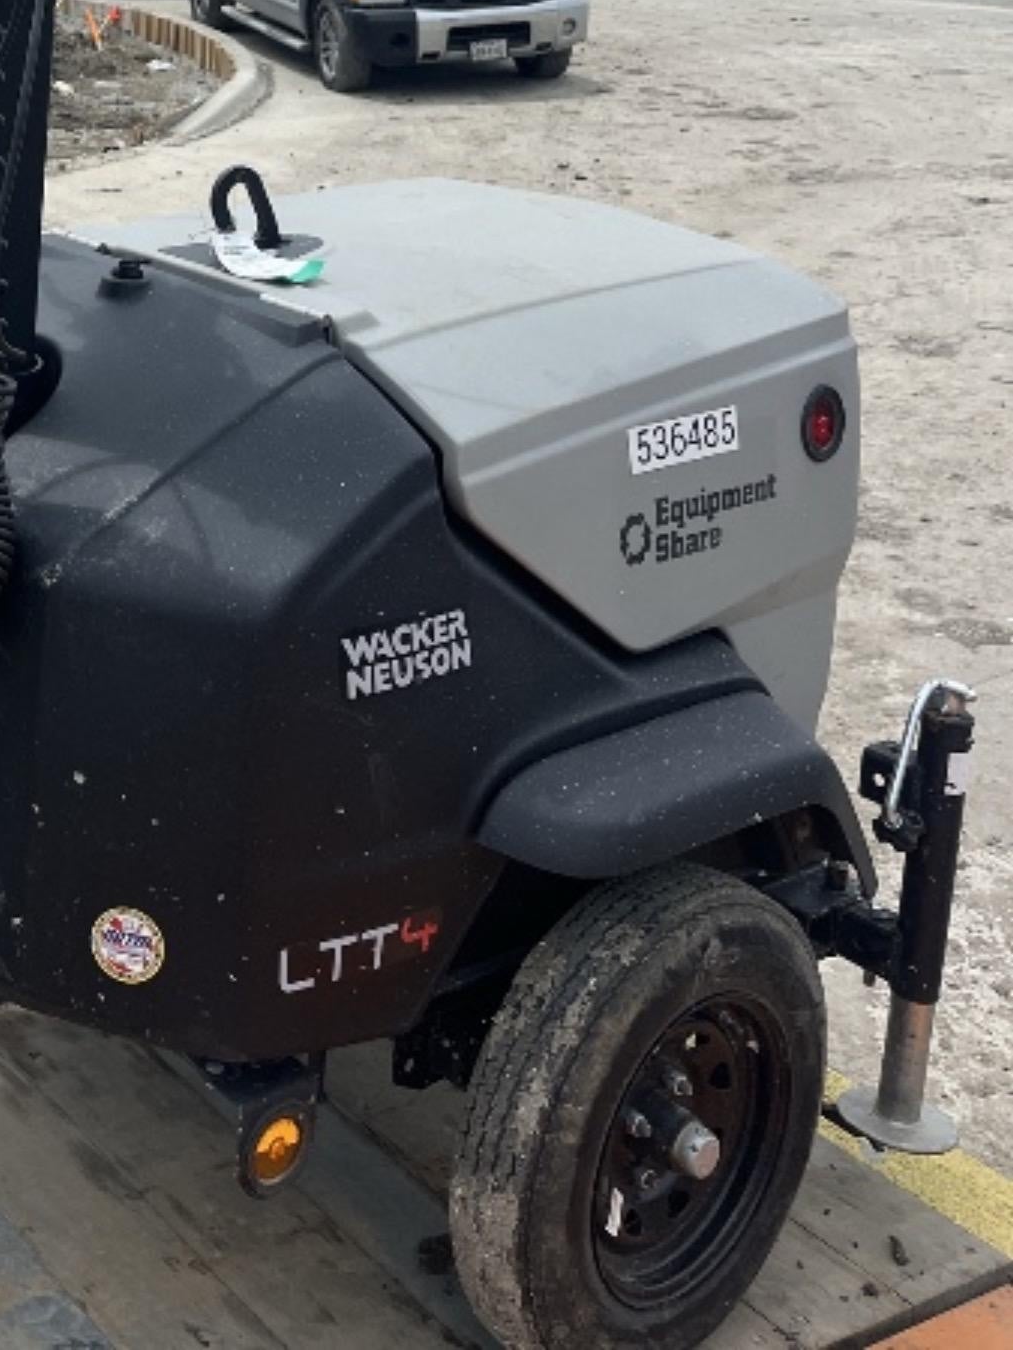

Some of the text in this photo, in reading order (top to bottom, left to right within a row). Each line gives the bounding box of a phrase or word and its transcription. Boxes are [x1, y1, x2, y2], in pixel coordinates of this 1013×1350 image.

[636, 409, 736, 465] 536485
[655, 473, 777, 529] Equipment
[655, 525, 723, 563] Share
[340, 608, 468, 667] WACKER
[346, 637, 472, 701] NEUSON
